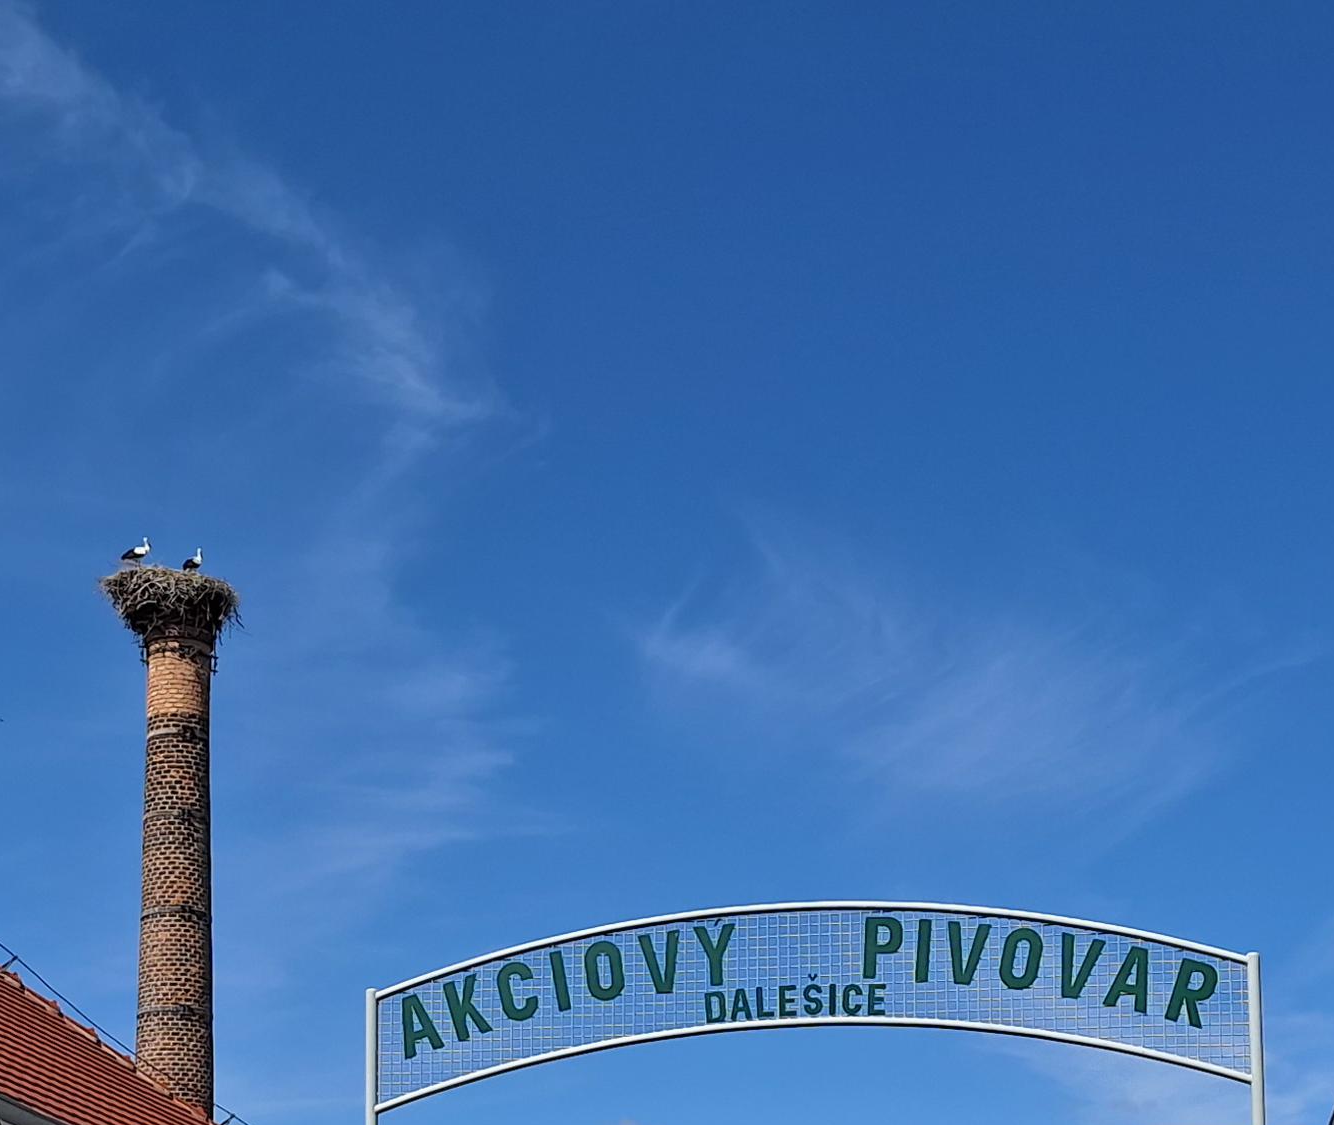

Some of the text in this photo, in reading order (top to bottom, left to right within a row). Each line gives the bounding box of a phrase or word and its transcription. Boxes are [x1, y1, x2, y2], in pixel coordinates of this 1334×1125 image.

[401, 916, 1219, 1059] AKCIOVÝ PIVOVAR
[704, 973, 887, 1024] DALEŠICE
